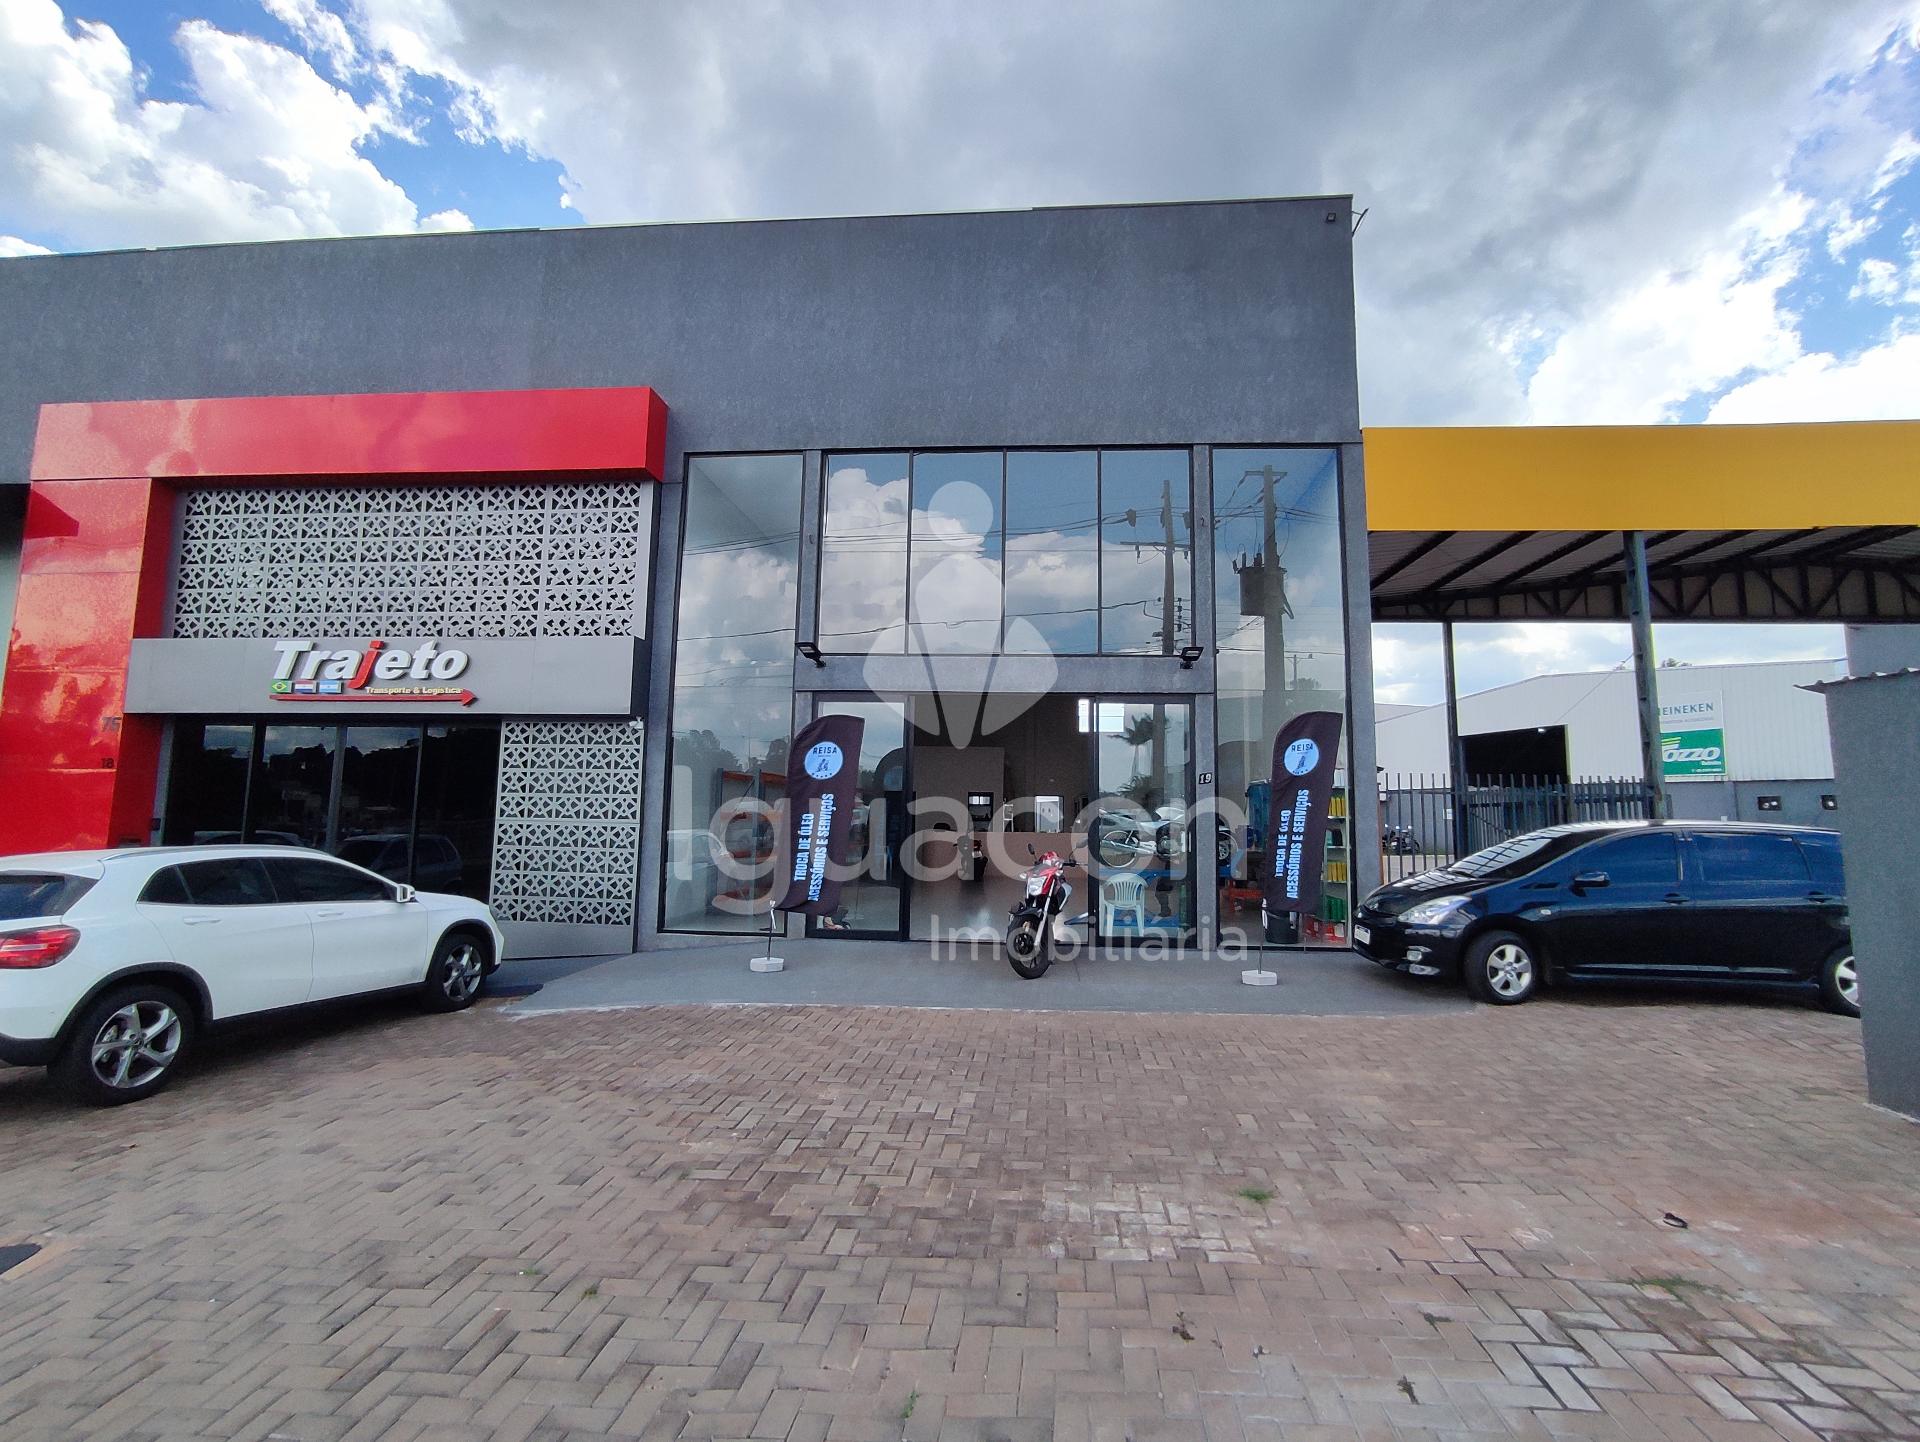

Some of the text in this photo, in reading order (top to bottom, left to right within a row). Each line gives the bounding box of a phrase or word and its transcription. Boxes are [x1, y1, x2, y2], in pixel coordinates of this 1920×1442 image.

[272, 640, 469, 689] Trajeto
[365, 687, 411, 695] Transporte
[1657, 703, 1714, 716] EINEKEN
[812, 746, 838, 755] REISA
[1291, 743, 1314, 752] REISA
[1199, 773, 1212, 784] 19
[1292, 789, 1312, 833] SERVIÇOS
[794, 813, 814, 881] TROCA DE ÓLEO
[808, 793, 836, 901] ACESSÓRIOS E SERVIÇOS
[1275, 810, 1291, 878] TROCA DE ÓLEO
[1286, 843, 1303, 899] ACESSÓRIOS
